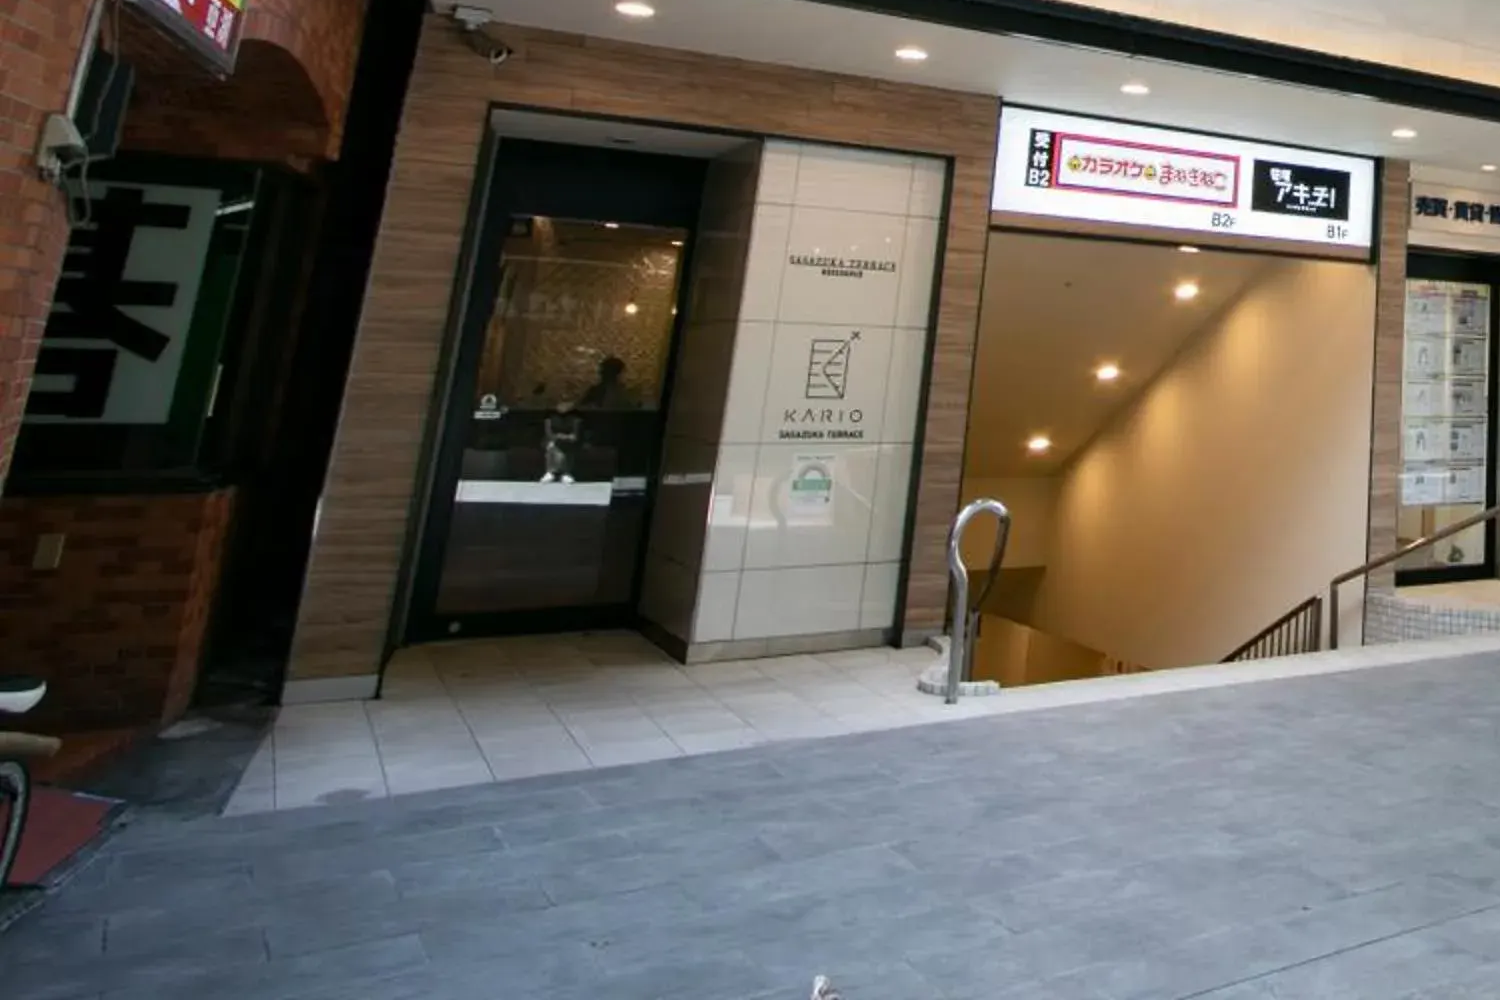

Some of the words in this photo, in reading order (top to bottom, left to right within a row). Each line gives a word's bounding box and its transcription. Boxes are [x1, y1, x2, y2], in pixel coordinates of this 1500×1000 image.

[1081, 155, 1144, 179] カラオケ
[1211, 211, 1237, 229] B2F
[1326, 223, 1349, 240] B1F
[783, 407, 864, 423] KARIO
